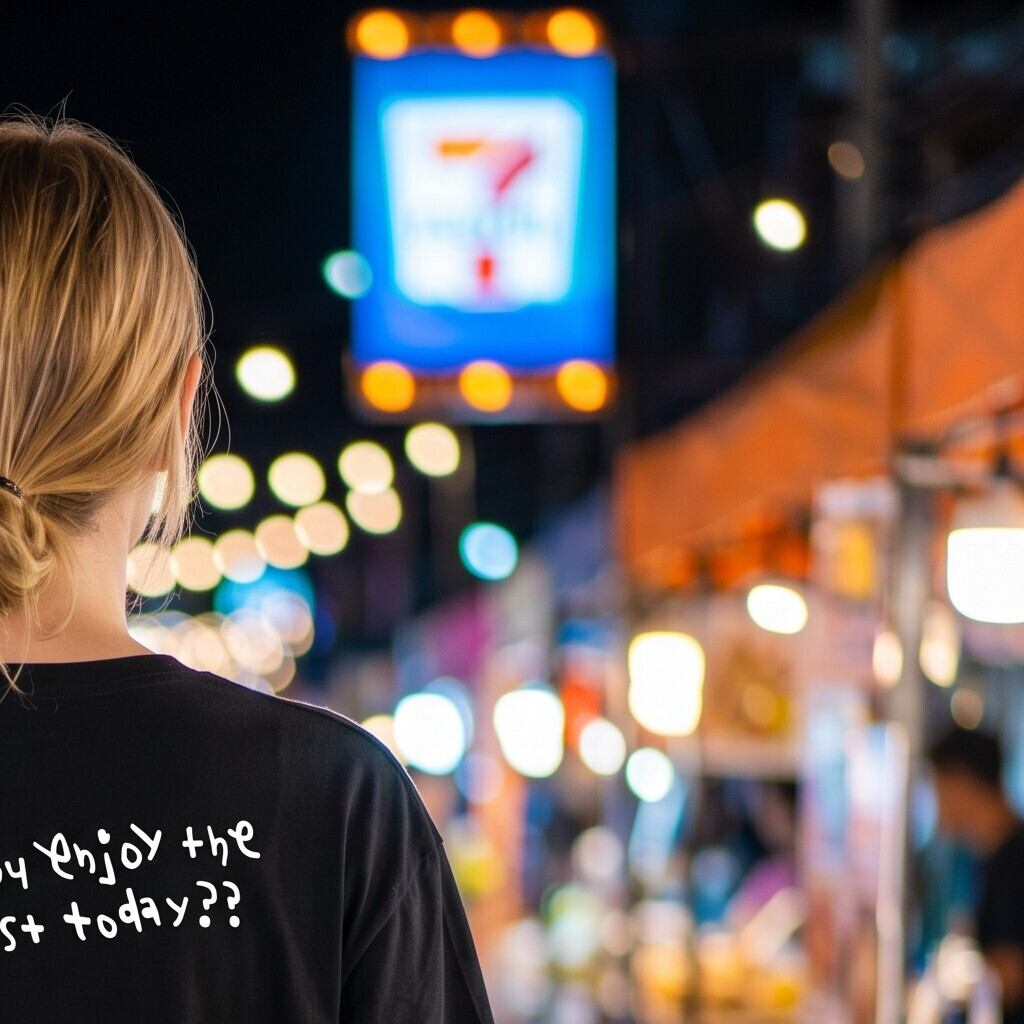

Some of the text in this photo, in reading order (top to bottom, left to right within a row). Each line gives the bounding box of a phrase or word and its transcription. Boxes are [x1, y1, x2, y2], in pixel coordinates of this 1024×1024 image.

[32, 823, 162, 886] enjoy
[181, 820, 261, 867] the
[62, 880, 241, 941] today??
